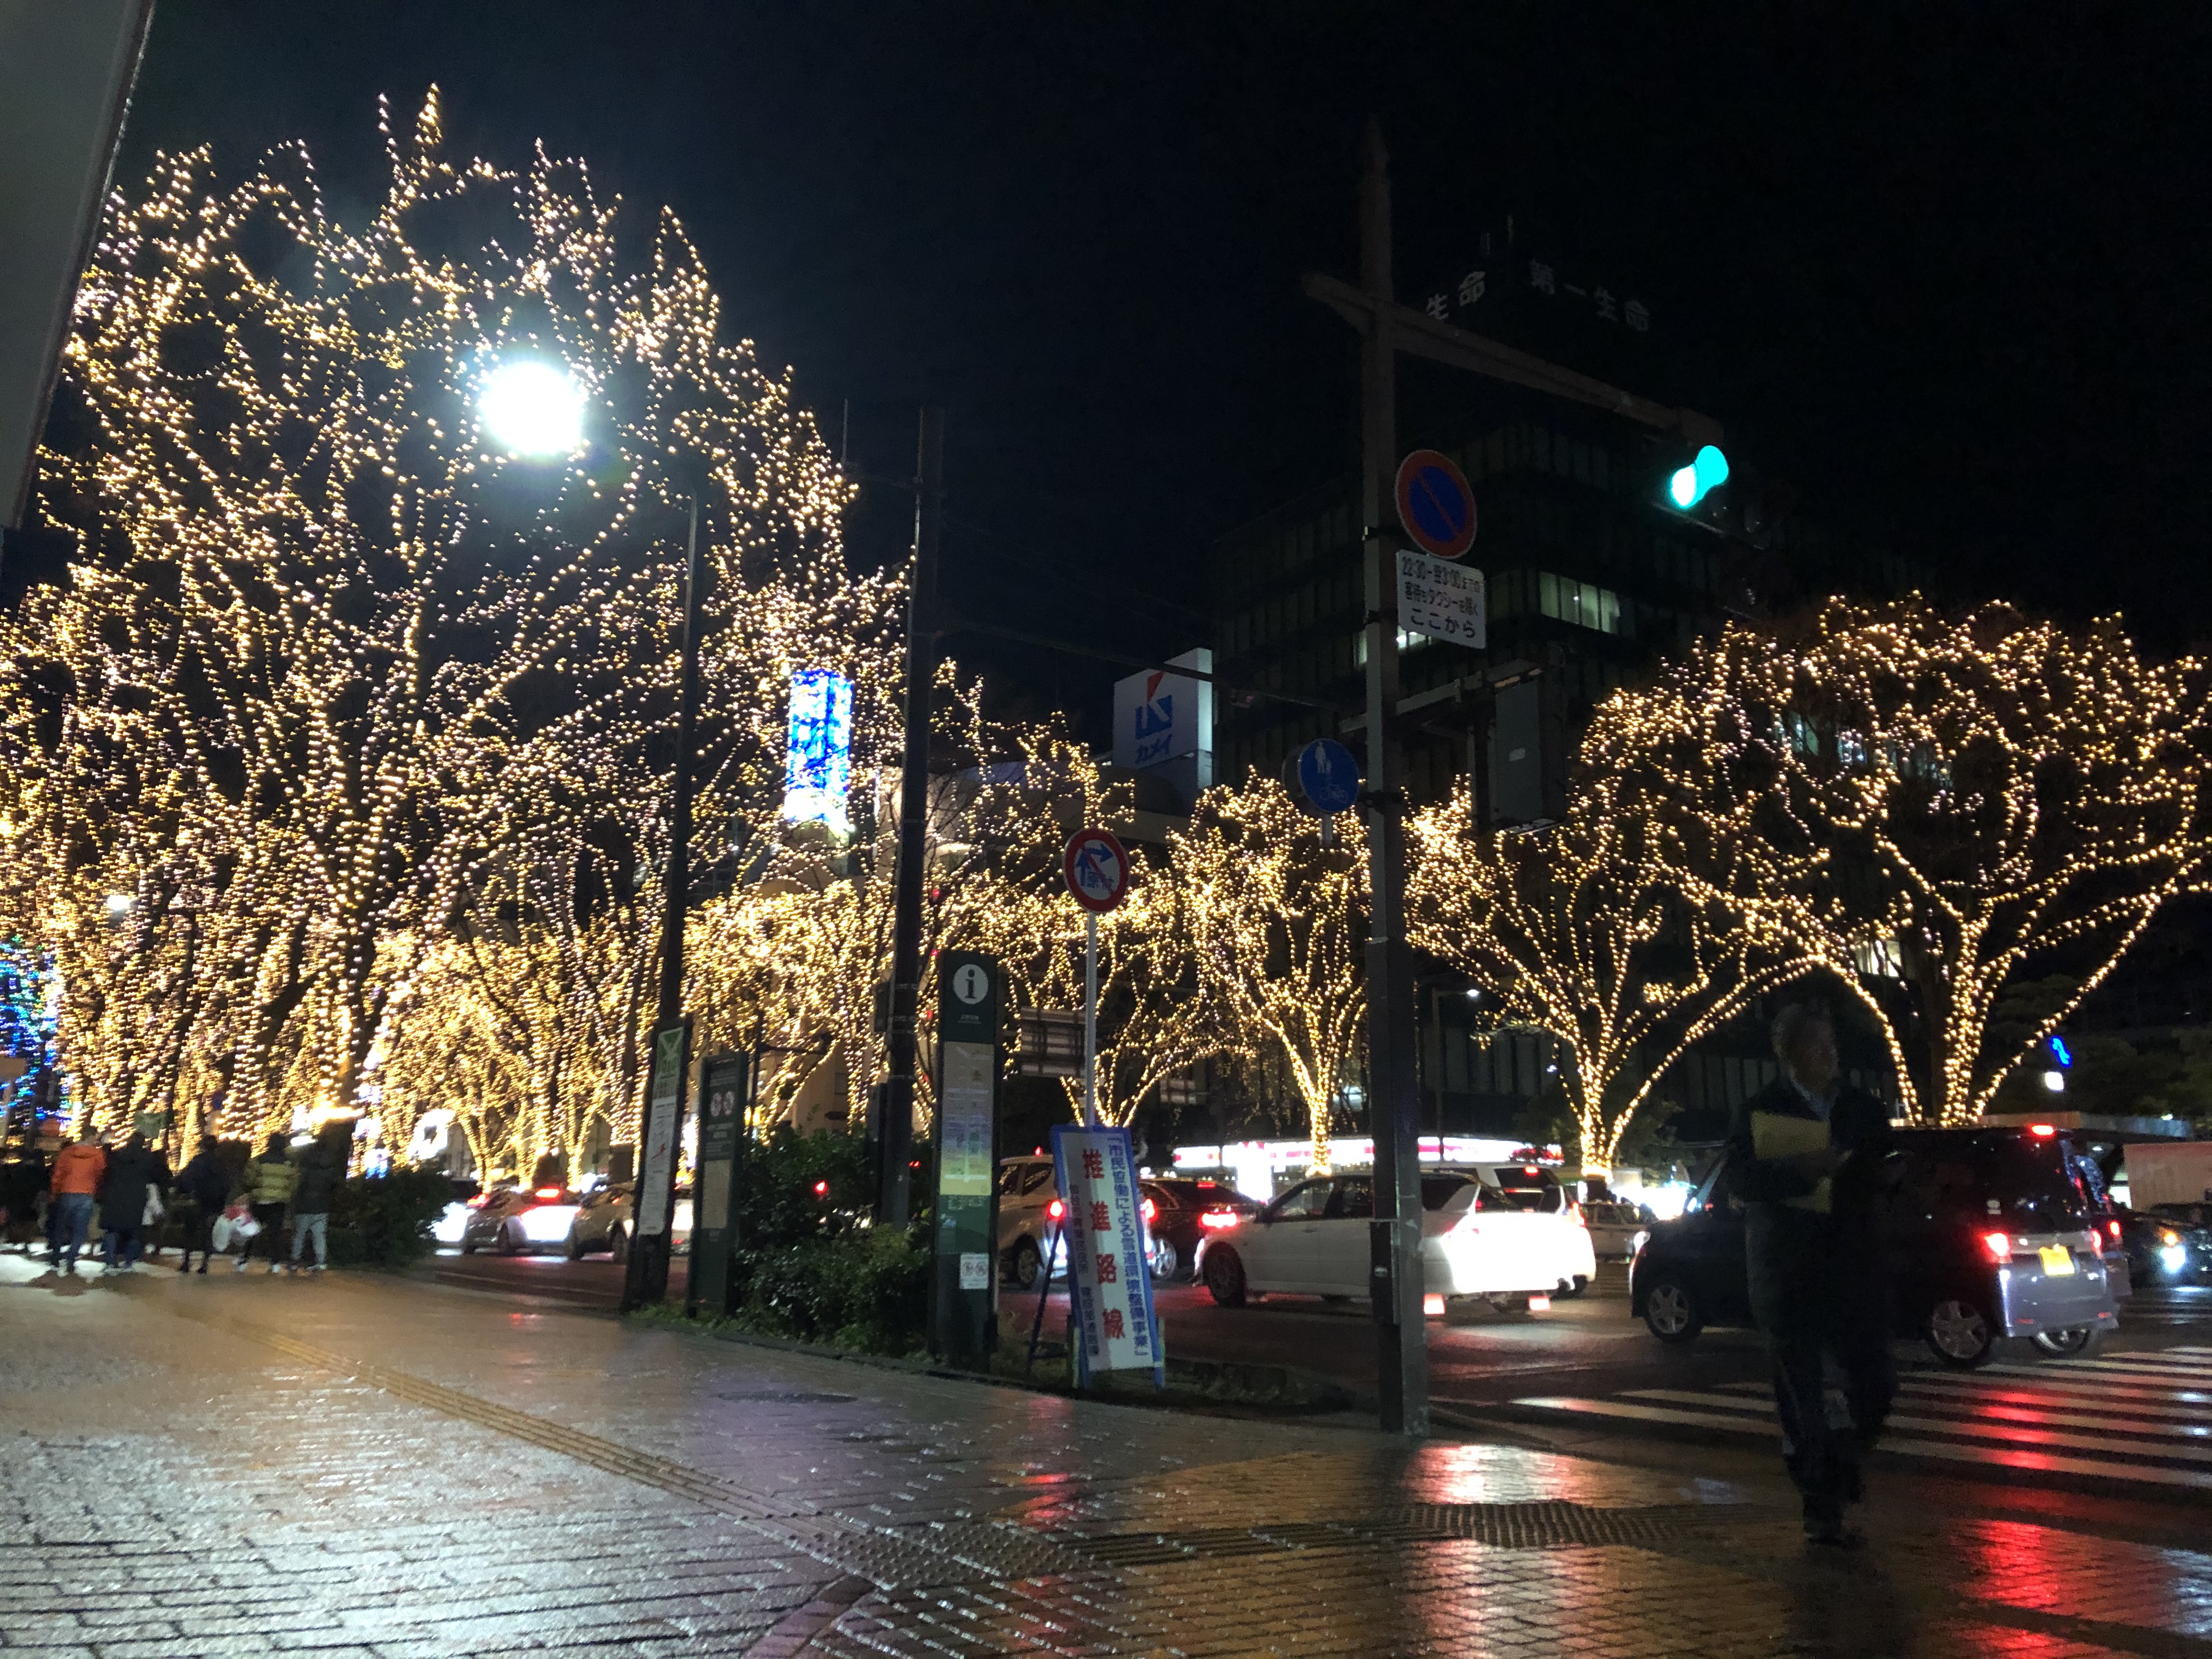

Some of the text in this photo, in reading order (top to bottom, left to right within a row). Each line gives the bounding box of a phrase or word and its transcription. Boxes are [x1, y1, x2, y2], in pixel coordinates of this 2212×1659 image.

[1426, 270, 1486, 320] 生命
[1530, 258, 1650, 331] 第一生命
[1410, 607, 1476, 639] ここから
